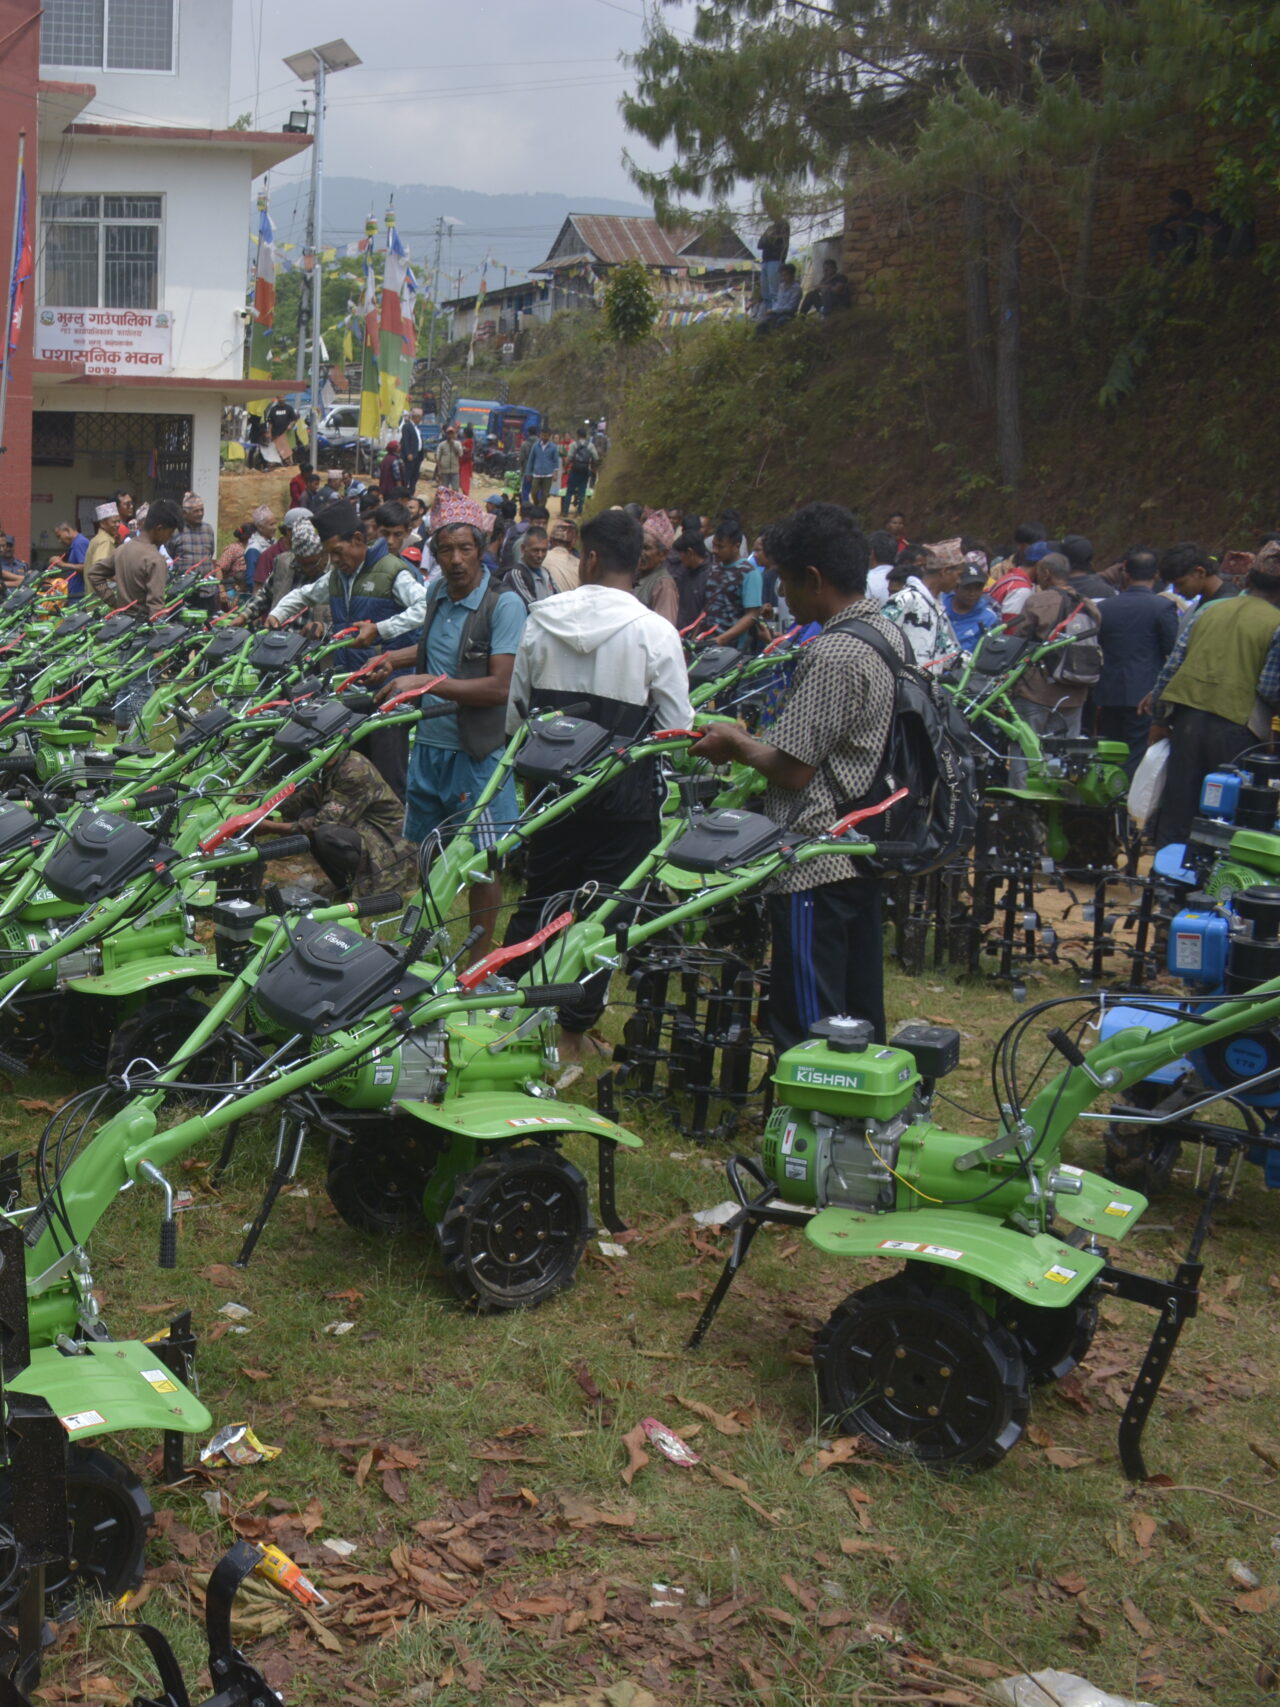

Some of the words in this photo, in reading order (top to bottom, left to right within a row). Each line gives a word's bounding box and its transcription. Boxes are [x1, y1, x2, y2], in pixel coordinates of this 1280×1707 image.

[124, 352, 164, 365] भवन
[324, 934, 351, 951] KISHAN
[796, 1070, 858, 1088] KISHAN
